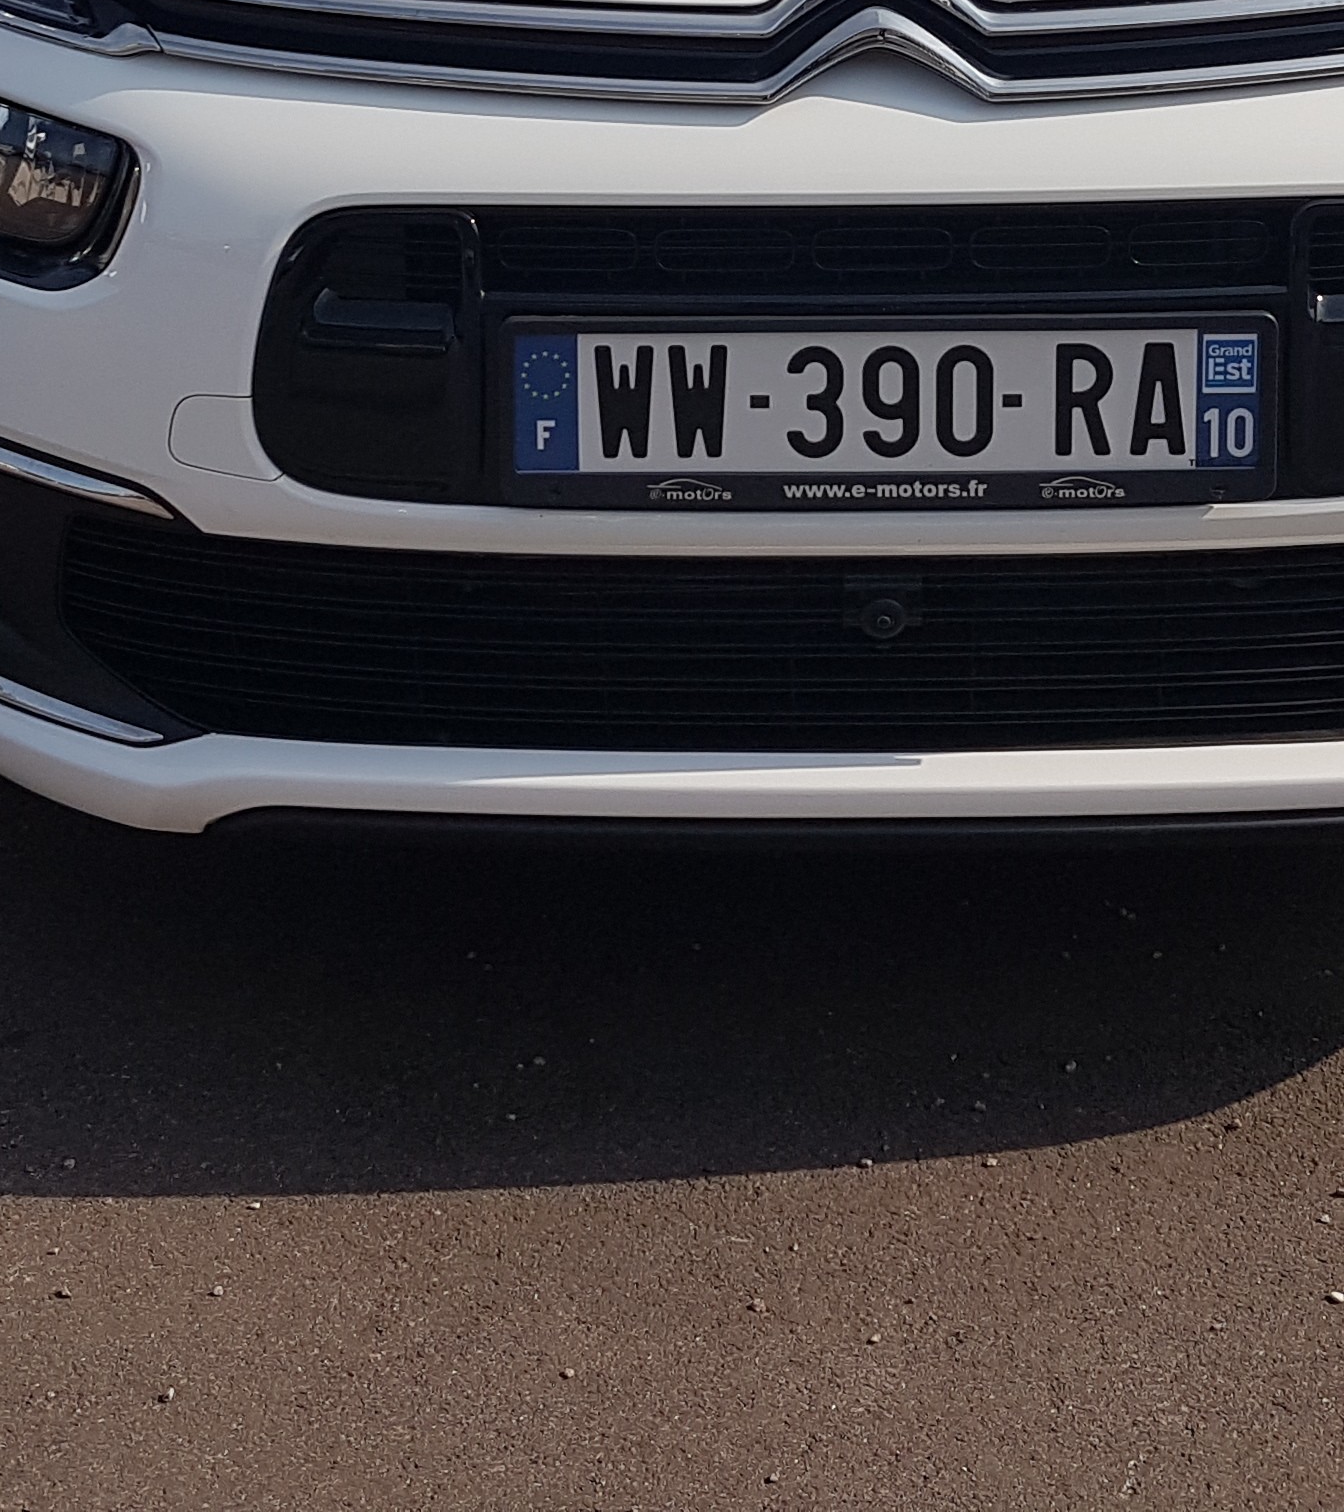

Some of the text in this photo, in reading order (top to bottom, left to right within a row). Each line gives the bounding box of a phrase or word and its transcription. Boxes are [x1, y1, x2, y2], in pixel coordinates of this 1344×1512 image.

[1208, 344, 1253, 357] Grand
[1207, 357, 1252, 381] Est
[535, 420, 556, 451] F
[1203, 407, 1254, 458] 10
[783, 479, 988, 499] www.e-motors.fr
